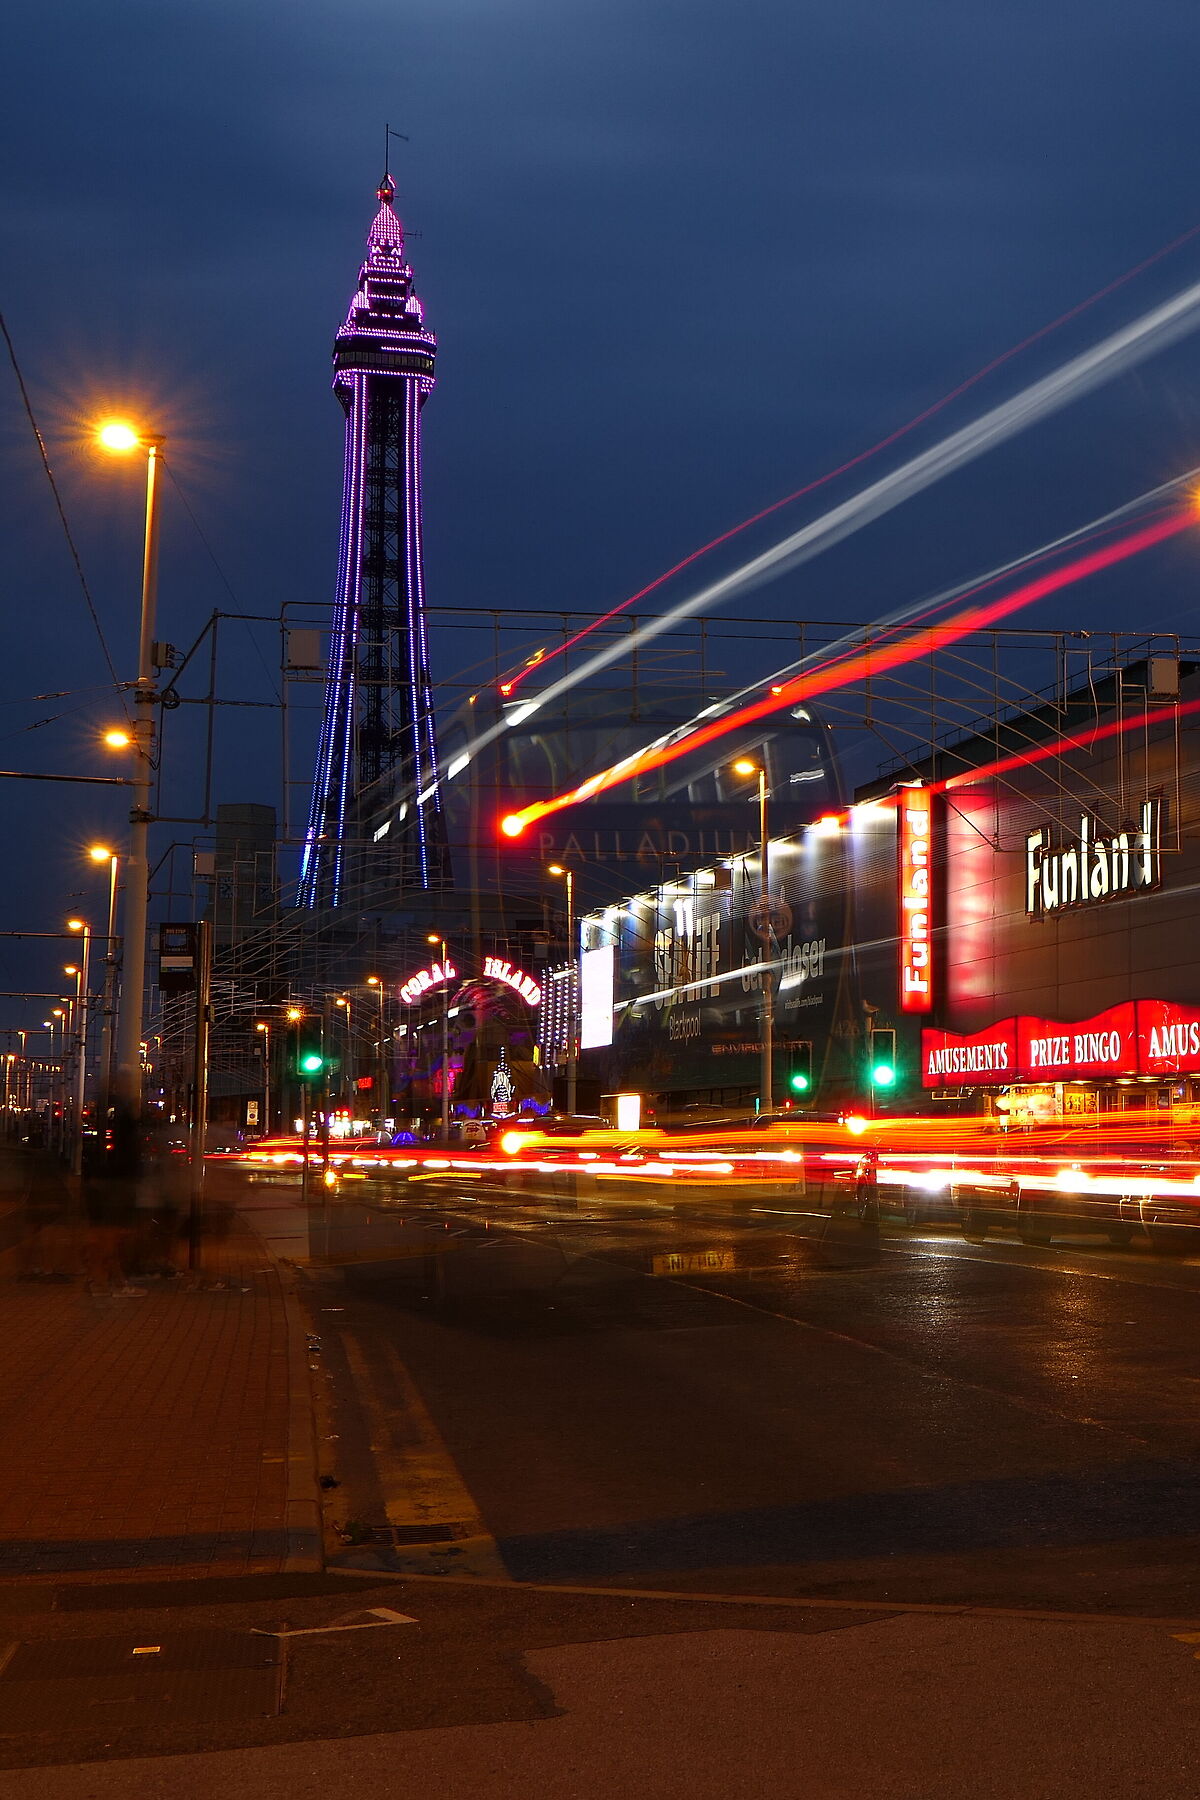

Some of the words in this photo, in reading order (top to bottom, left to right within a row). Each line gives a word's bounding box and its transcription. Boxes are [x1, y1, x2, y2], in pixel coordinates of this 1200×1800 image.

[1027, 801, 1152, 912] Funland
[905, 809, 928, 993] Funland
[400, 959, 456, 1004] CORAL
[483, 956, 542, 1006] ISLAND
[669, 1008, 702, 1047] Blackpool
[1030, 1035, 1070, 1068] PRIZE
[1073, 1030, 1121, 1066] BINGO
[928, 1041, 1009, 1076] AMUSEMENTS
